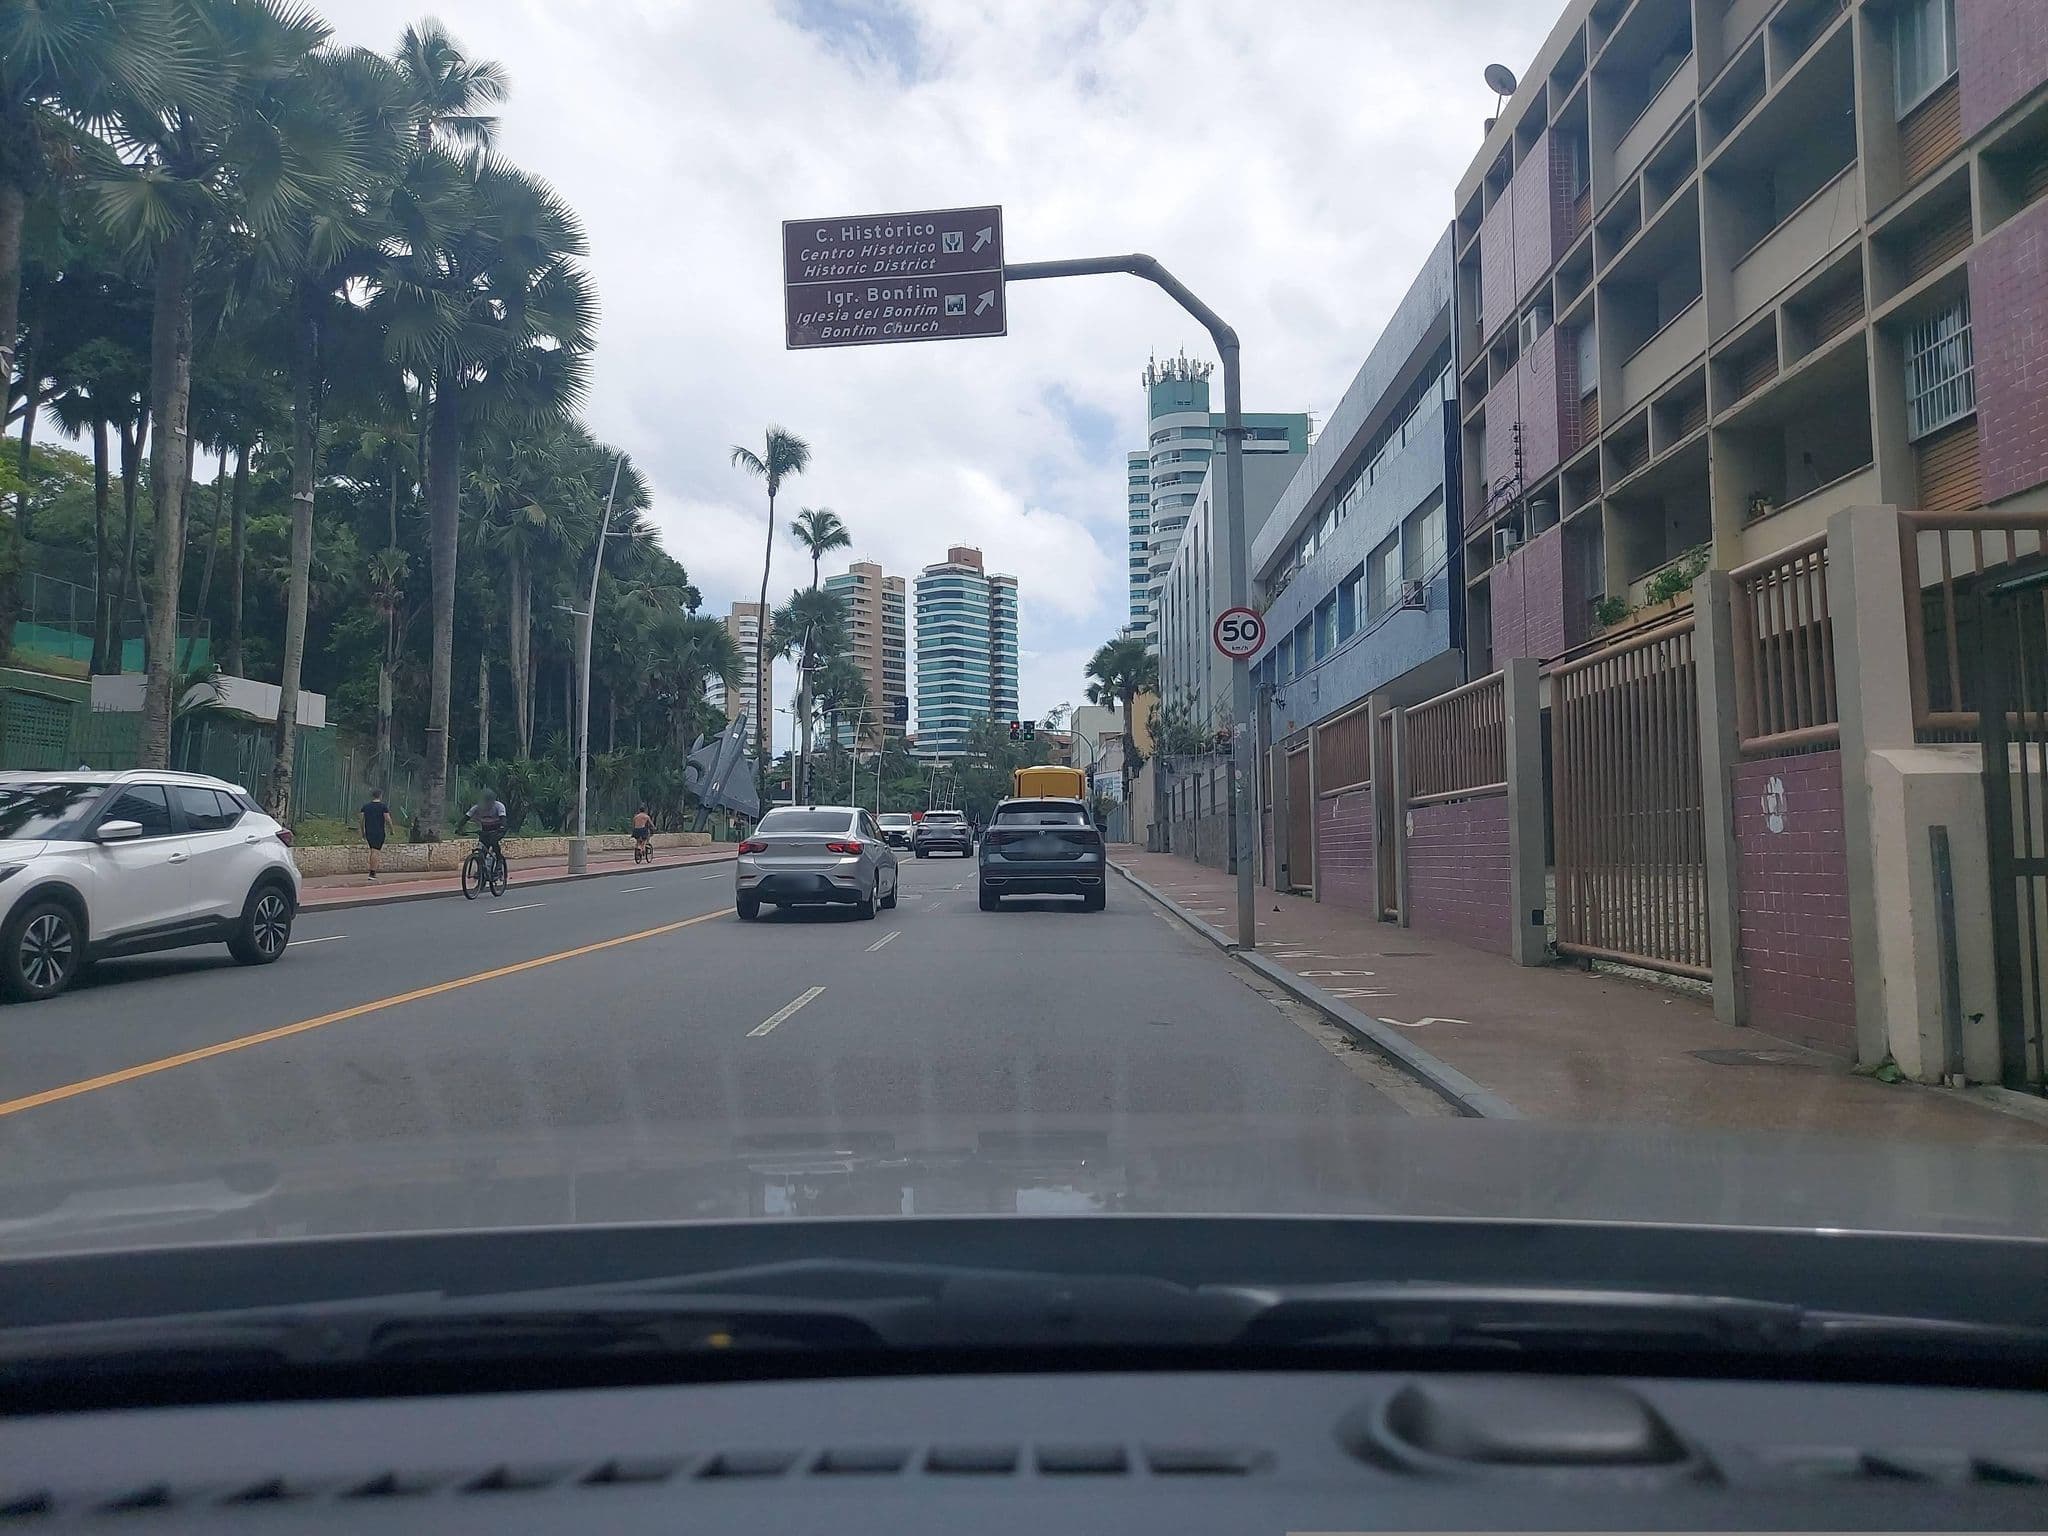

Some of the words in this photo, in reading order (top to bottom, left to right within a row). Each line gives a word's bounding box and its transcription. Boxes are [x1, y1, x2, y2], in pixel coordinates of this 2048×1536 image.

[815, 228, 834, 243] C.
[841, 221, 936, 242] Histórico
[800, 248, 855, 262] Centro
[860, 240, 936, 257] Histórico
[804, 262, 868, 278] Historic
[873, 257, 937, 273] District
[826, 290, 860, 308] Igr.
[867, 285, 939, 302] Bonfim
[796, 307, 849, 326] Iglesia
[854, 308, 878, 320] del
[882, 303, 939, 318] Bonfim
[820, 325, 877, 339] Bonfim
[883, 319, 940, 335] Church
[1222, 619, 1259, 642] 50
